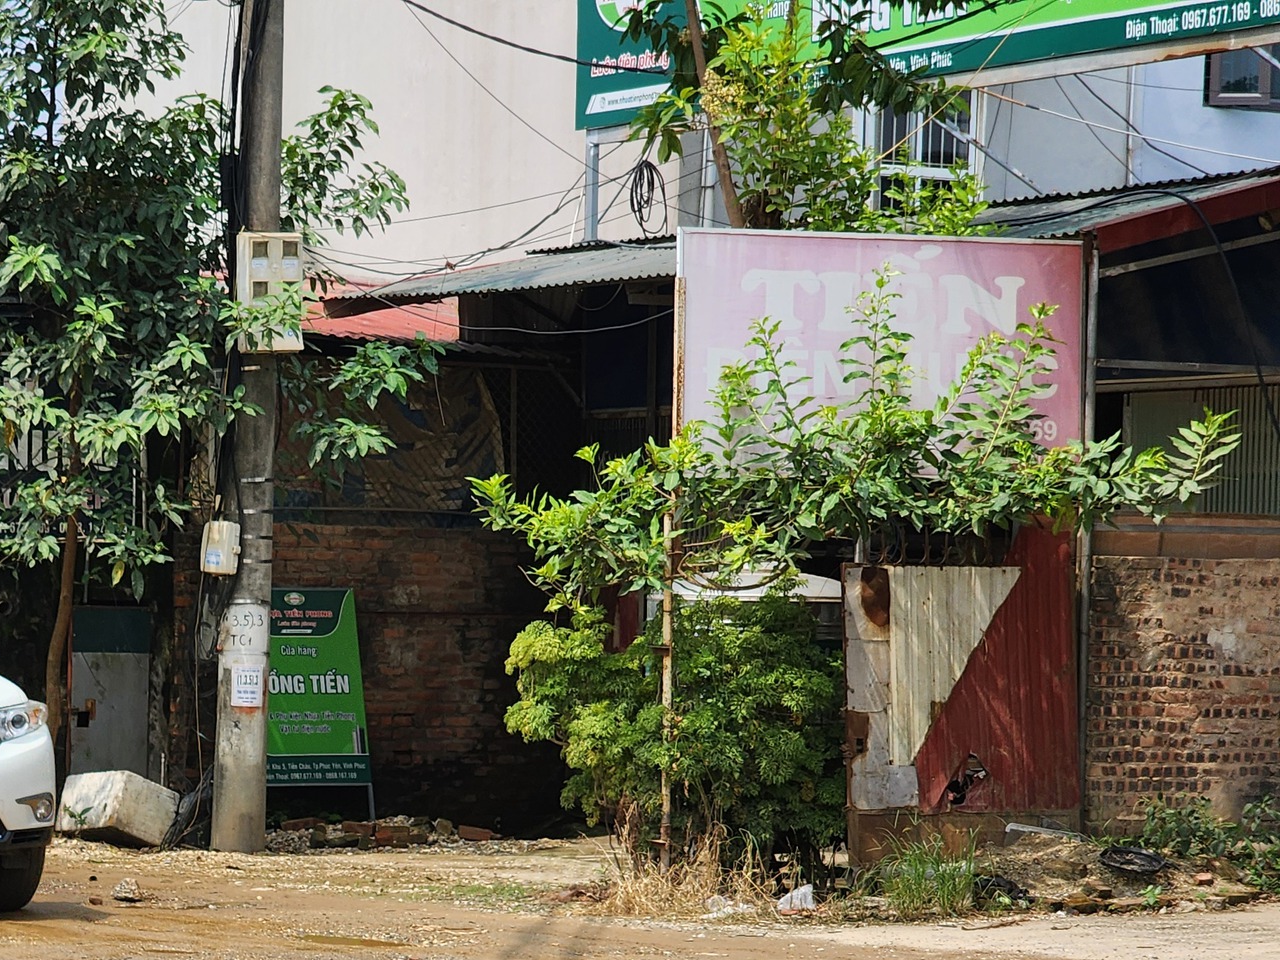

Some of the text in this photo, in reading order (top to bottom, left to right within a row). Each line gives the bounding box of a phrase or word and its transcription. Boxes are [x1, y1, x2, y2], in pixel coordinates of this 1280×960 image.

[1125, 19, 1147, 40] Điện
[1150, 14, 1179, 38] Thoại:
[1182, 2, 1250, 30] 0967.677.169
[268, 668, 351, 694] ỒNG TIẾN
